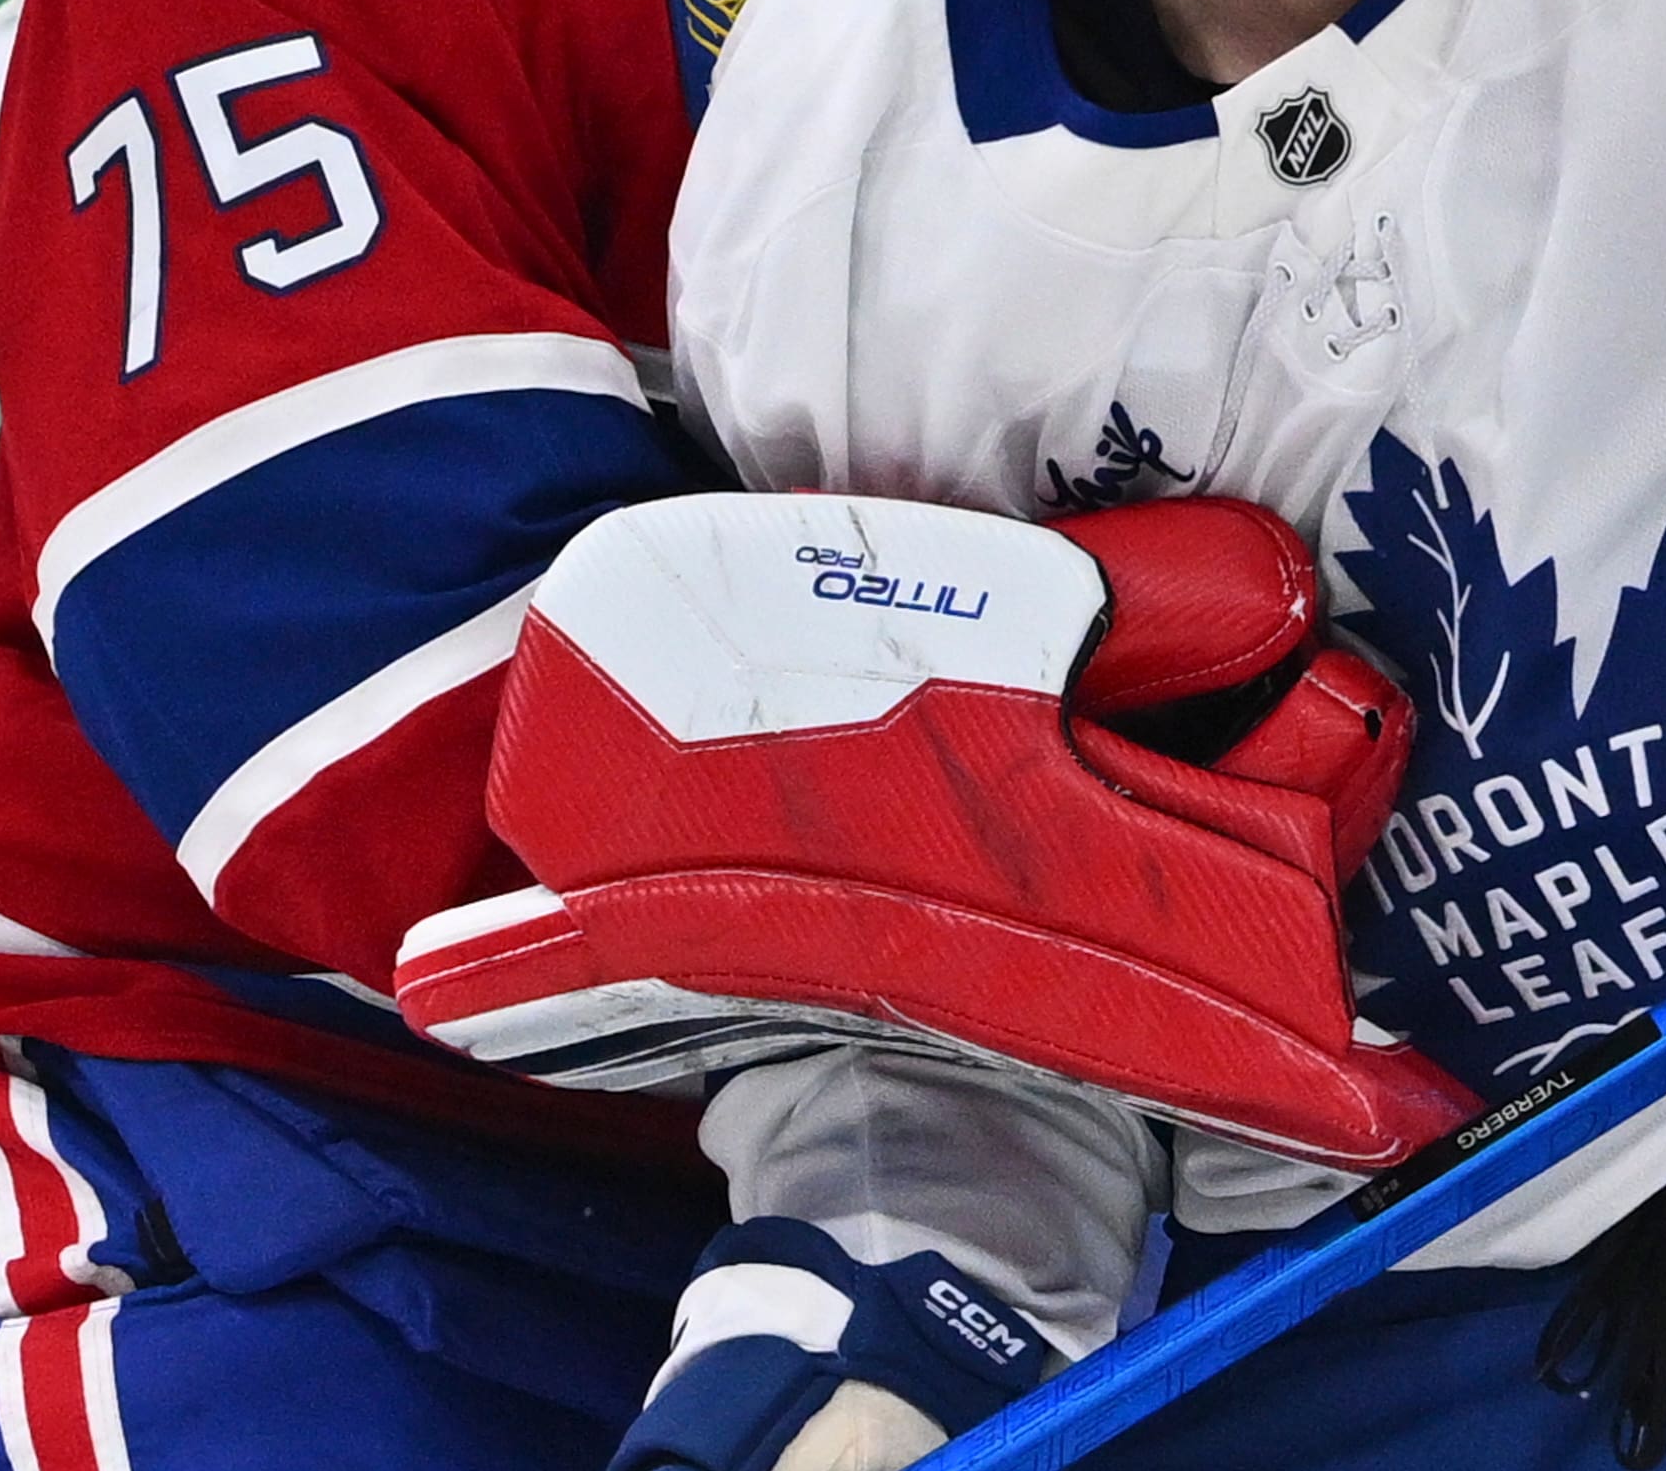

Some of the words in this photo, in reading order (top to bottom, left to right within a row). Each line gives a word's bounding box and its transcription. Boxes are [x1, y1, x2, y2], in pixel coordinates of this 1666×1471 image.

[66, 31, 388, 385] 75
[795, 546, 865, 569] PRO
[813, 570, 989, 620] NITRO
[1456, 1070, 1575, 1150] TVERBERG
[928, 1279, 1027, 1357] CCM
